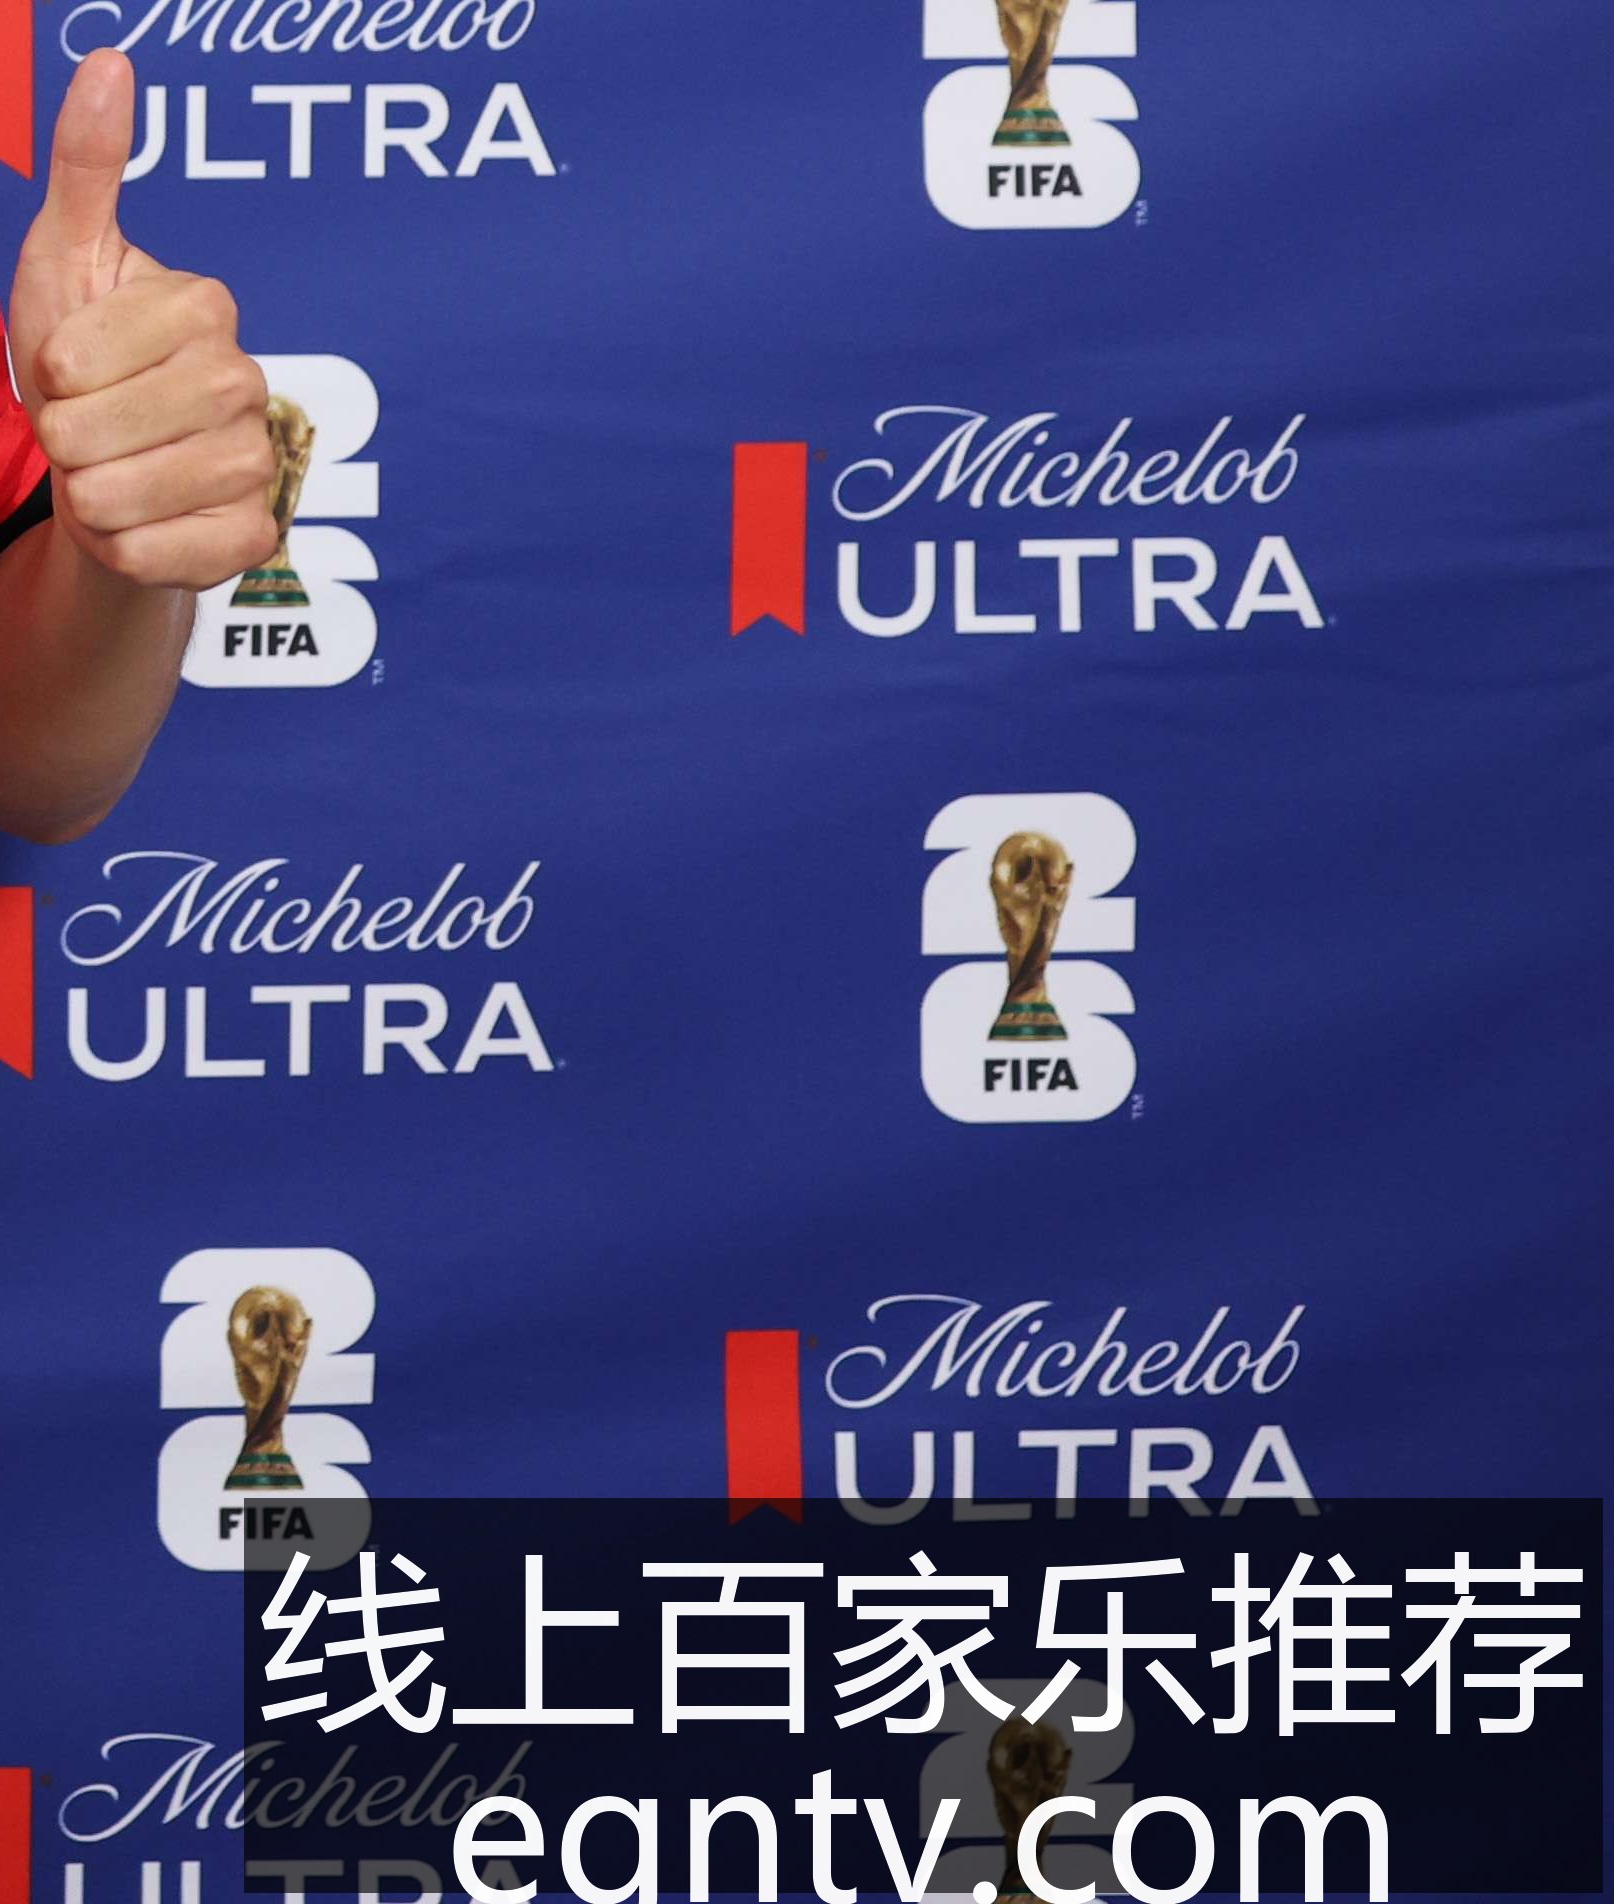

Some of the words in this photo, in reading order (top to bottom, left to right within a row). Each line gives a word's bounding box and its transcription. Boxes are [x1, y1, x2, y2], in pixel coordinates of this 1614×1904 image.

[988, 164, 1083, 198] FIFA
[833, 406, 1304, 520] Michelob
[838, 536, 1323, 636] ULTRA
[224, 623, 319, 658] FIFA
[62, 851, 539, 965] Michelob
[68, 983, 553, 1081] ULTRA
[984, 1057, 1079, 1093] FIFA
[826, 1294, 1305, 1408] Michelob
[219, 1506, 314, 1540] FIFA
[834, 1425, 1321, 1525] ULTRA
